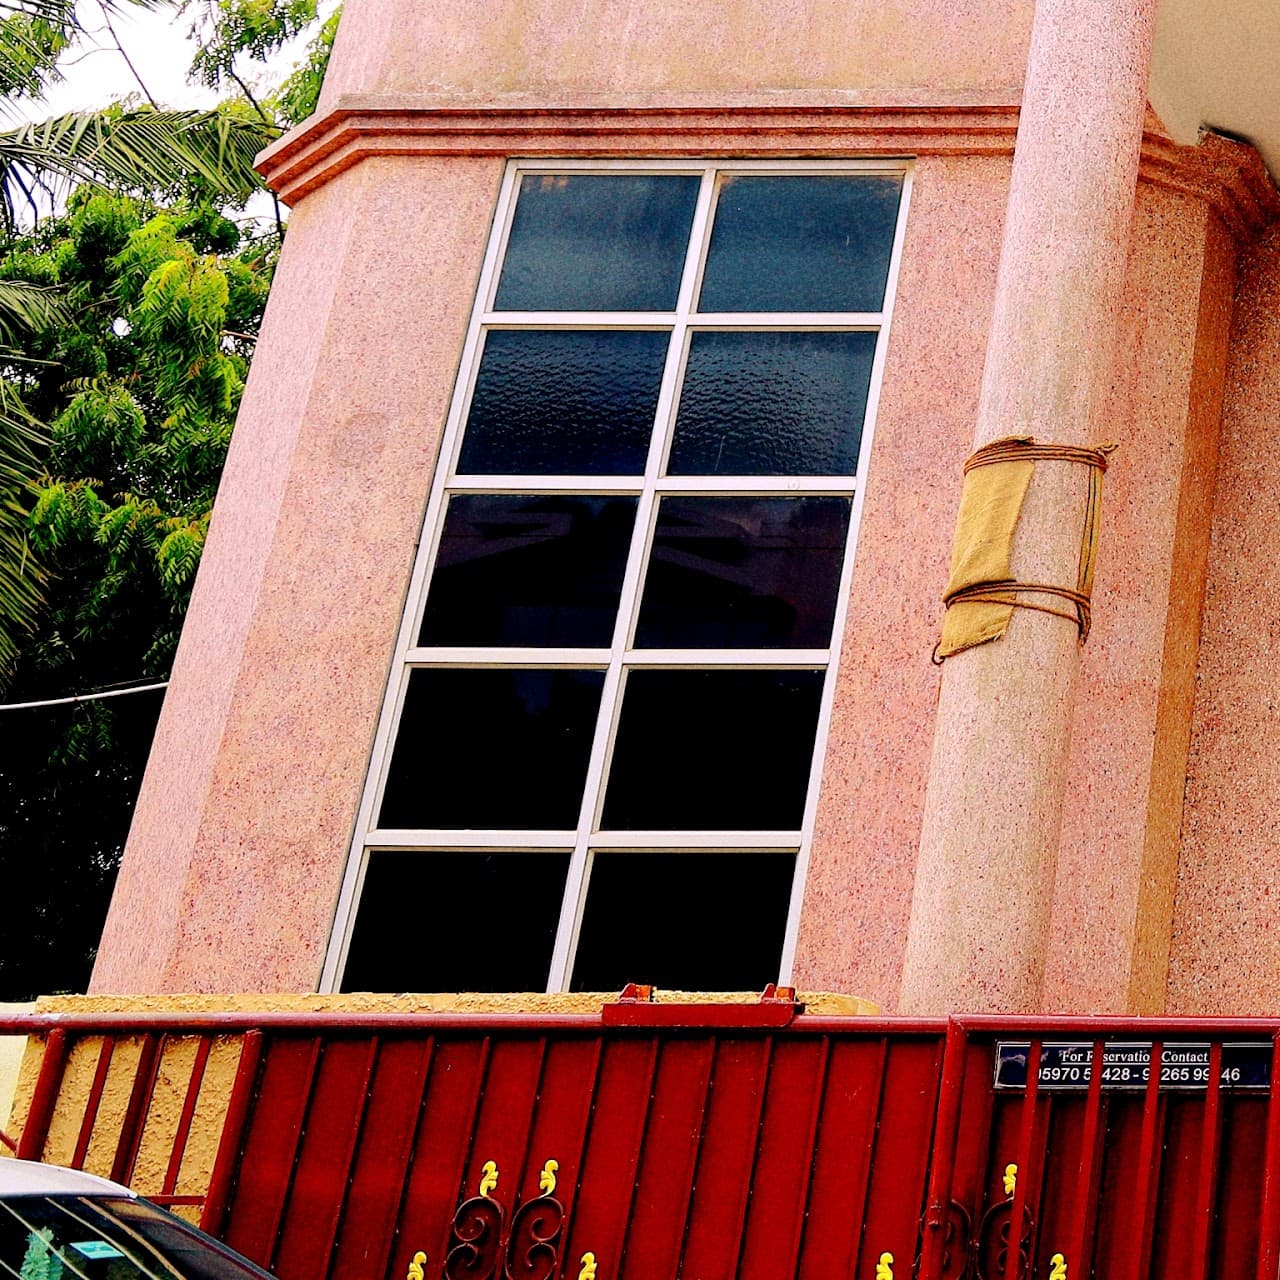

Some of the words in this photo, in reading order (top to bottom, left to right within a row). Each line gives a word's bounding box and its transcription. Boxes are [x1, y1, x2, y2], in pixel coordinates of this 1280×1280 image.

[1062, 1050, 1083, 1062] For
[1086, 1050, 1151, 1062] Rservatio
[1161, 1051, 1208, 1062] Contact
[1038, 1068, 1080, 1081] 5970
[1083, 1068, 1131, 1081] 5428
[1142, 1068, 1190, 1081] 9265
[1193, 1068, 1240, 1081] 9946
